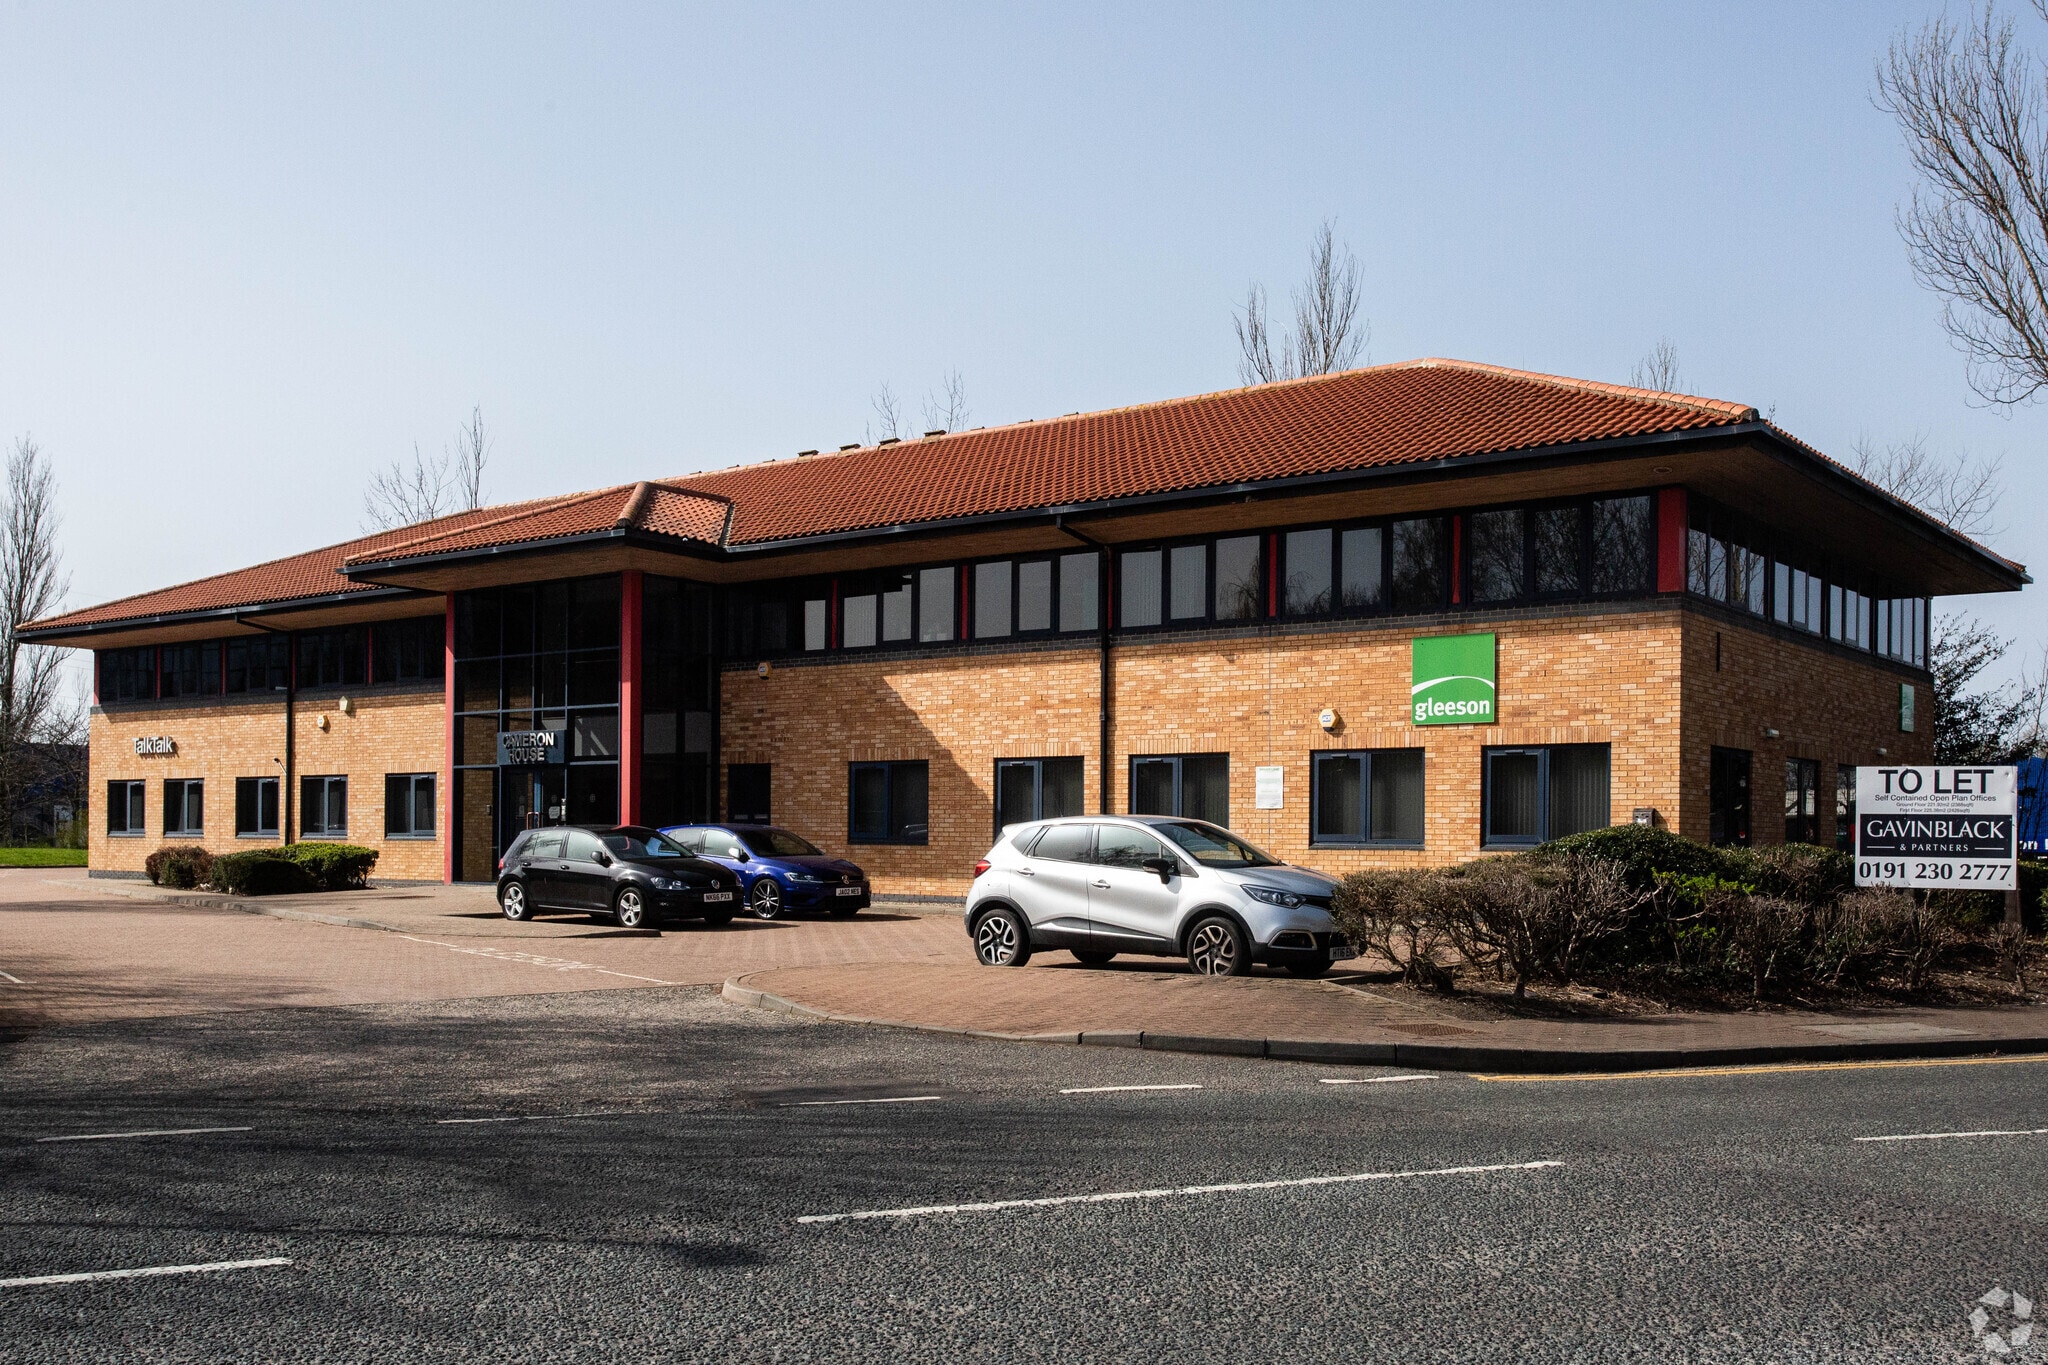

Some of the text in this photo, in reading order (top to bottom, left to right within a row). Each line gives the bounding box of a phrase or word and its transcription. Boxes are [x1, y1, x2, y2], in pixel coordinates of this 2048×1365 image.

[1415, 697, 1490, 721] gleeson
[132, 736, 173, 754] TalkTalk
[503, 732, 554, 748] CAMERON
[509, 747, 545, 763] HOUSE
[1878, 769, 1994, 794] TO LET
[1875, 794, 1889, 802] Self
[1891, 794, 1927, 802] Contained
[1929, 795, 1950, 804] Open
[1859, 862, 2012, 880] 0191 230 2777
